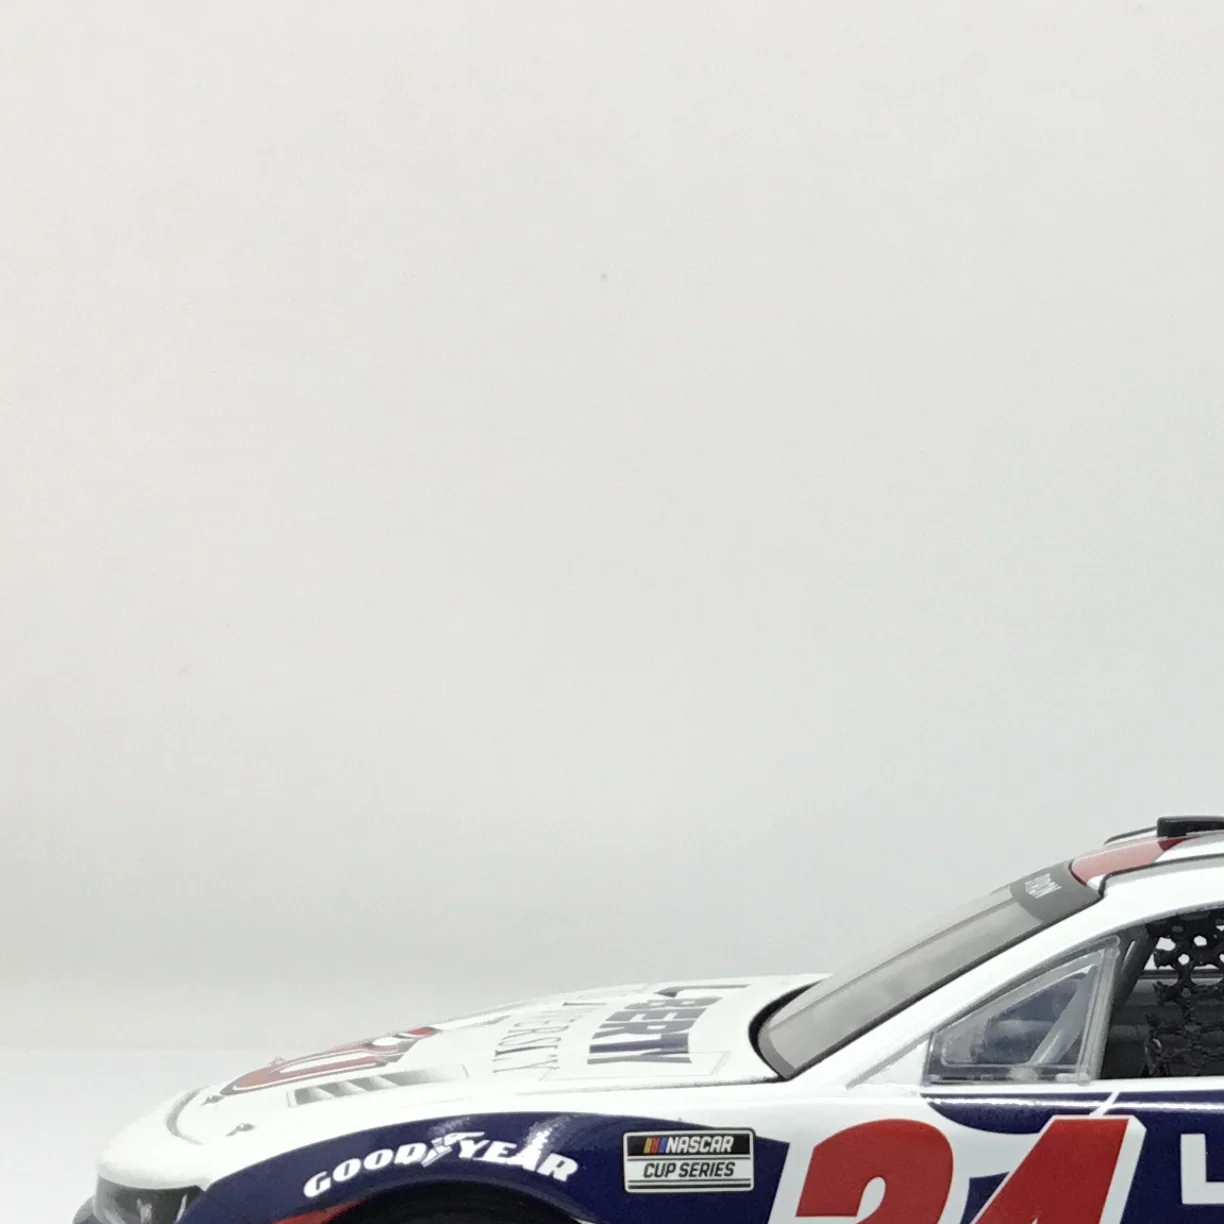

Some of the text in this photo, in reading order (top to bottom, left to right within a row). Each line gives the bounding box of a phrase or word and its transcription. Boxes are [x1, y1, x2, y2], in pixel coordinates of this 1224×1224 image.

[665, 1135, 735, 1154] NASCAR
[303, 1131, 579, 1199] GOODYEAR
[643, 1161, 736, 1178] CUP SERIES
